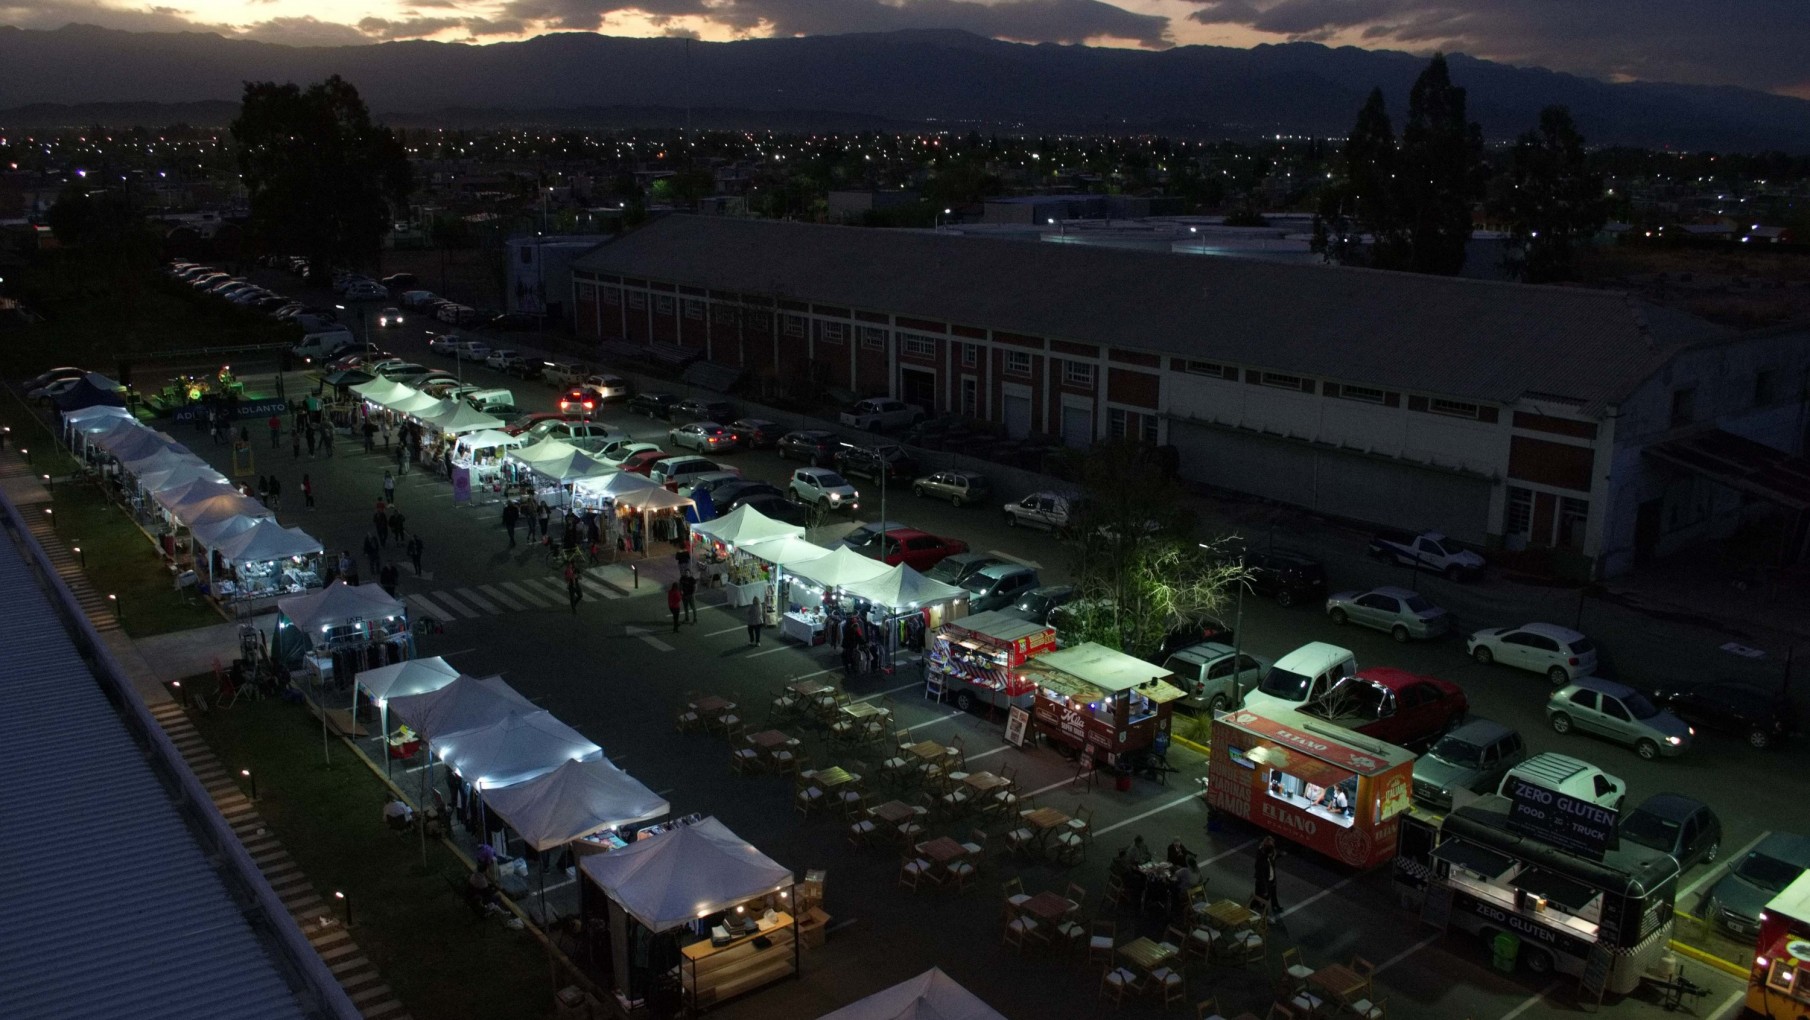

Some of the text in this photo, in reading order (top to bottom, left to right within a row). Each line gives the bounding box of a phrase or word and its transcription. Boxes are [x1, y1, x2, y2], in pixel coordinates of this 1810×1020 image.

[1061, 708, 1085, 728] Mila
[1290, 735, 1328, 751] TANO
[1217, 793, 1250, 817] AMOR
[1262, 802, 1317, 836] EL TANO
[1515, 783, 1615, 826] ZERO GLUTEN
[1518, 804, 1545, 819] FOOD
[1571, 822, 1606, 841] TRUCK
[1476, 902, 1505, 922] ZERO
[1509, 916, 1556, 943] GLUTEN
